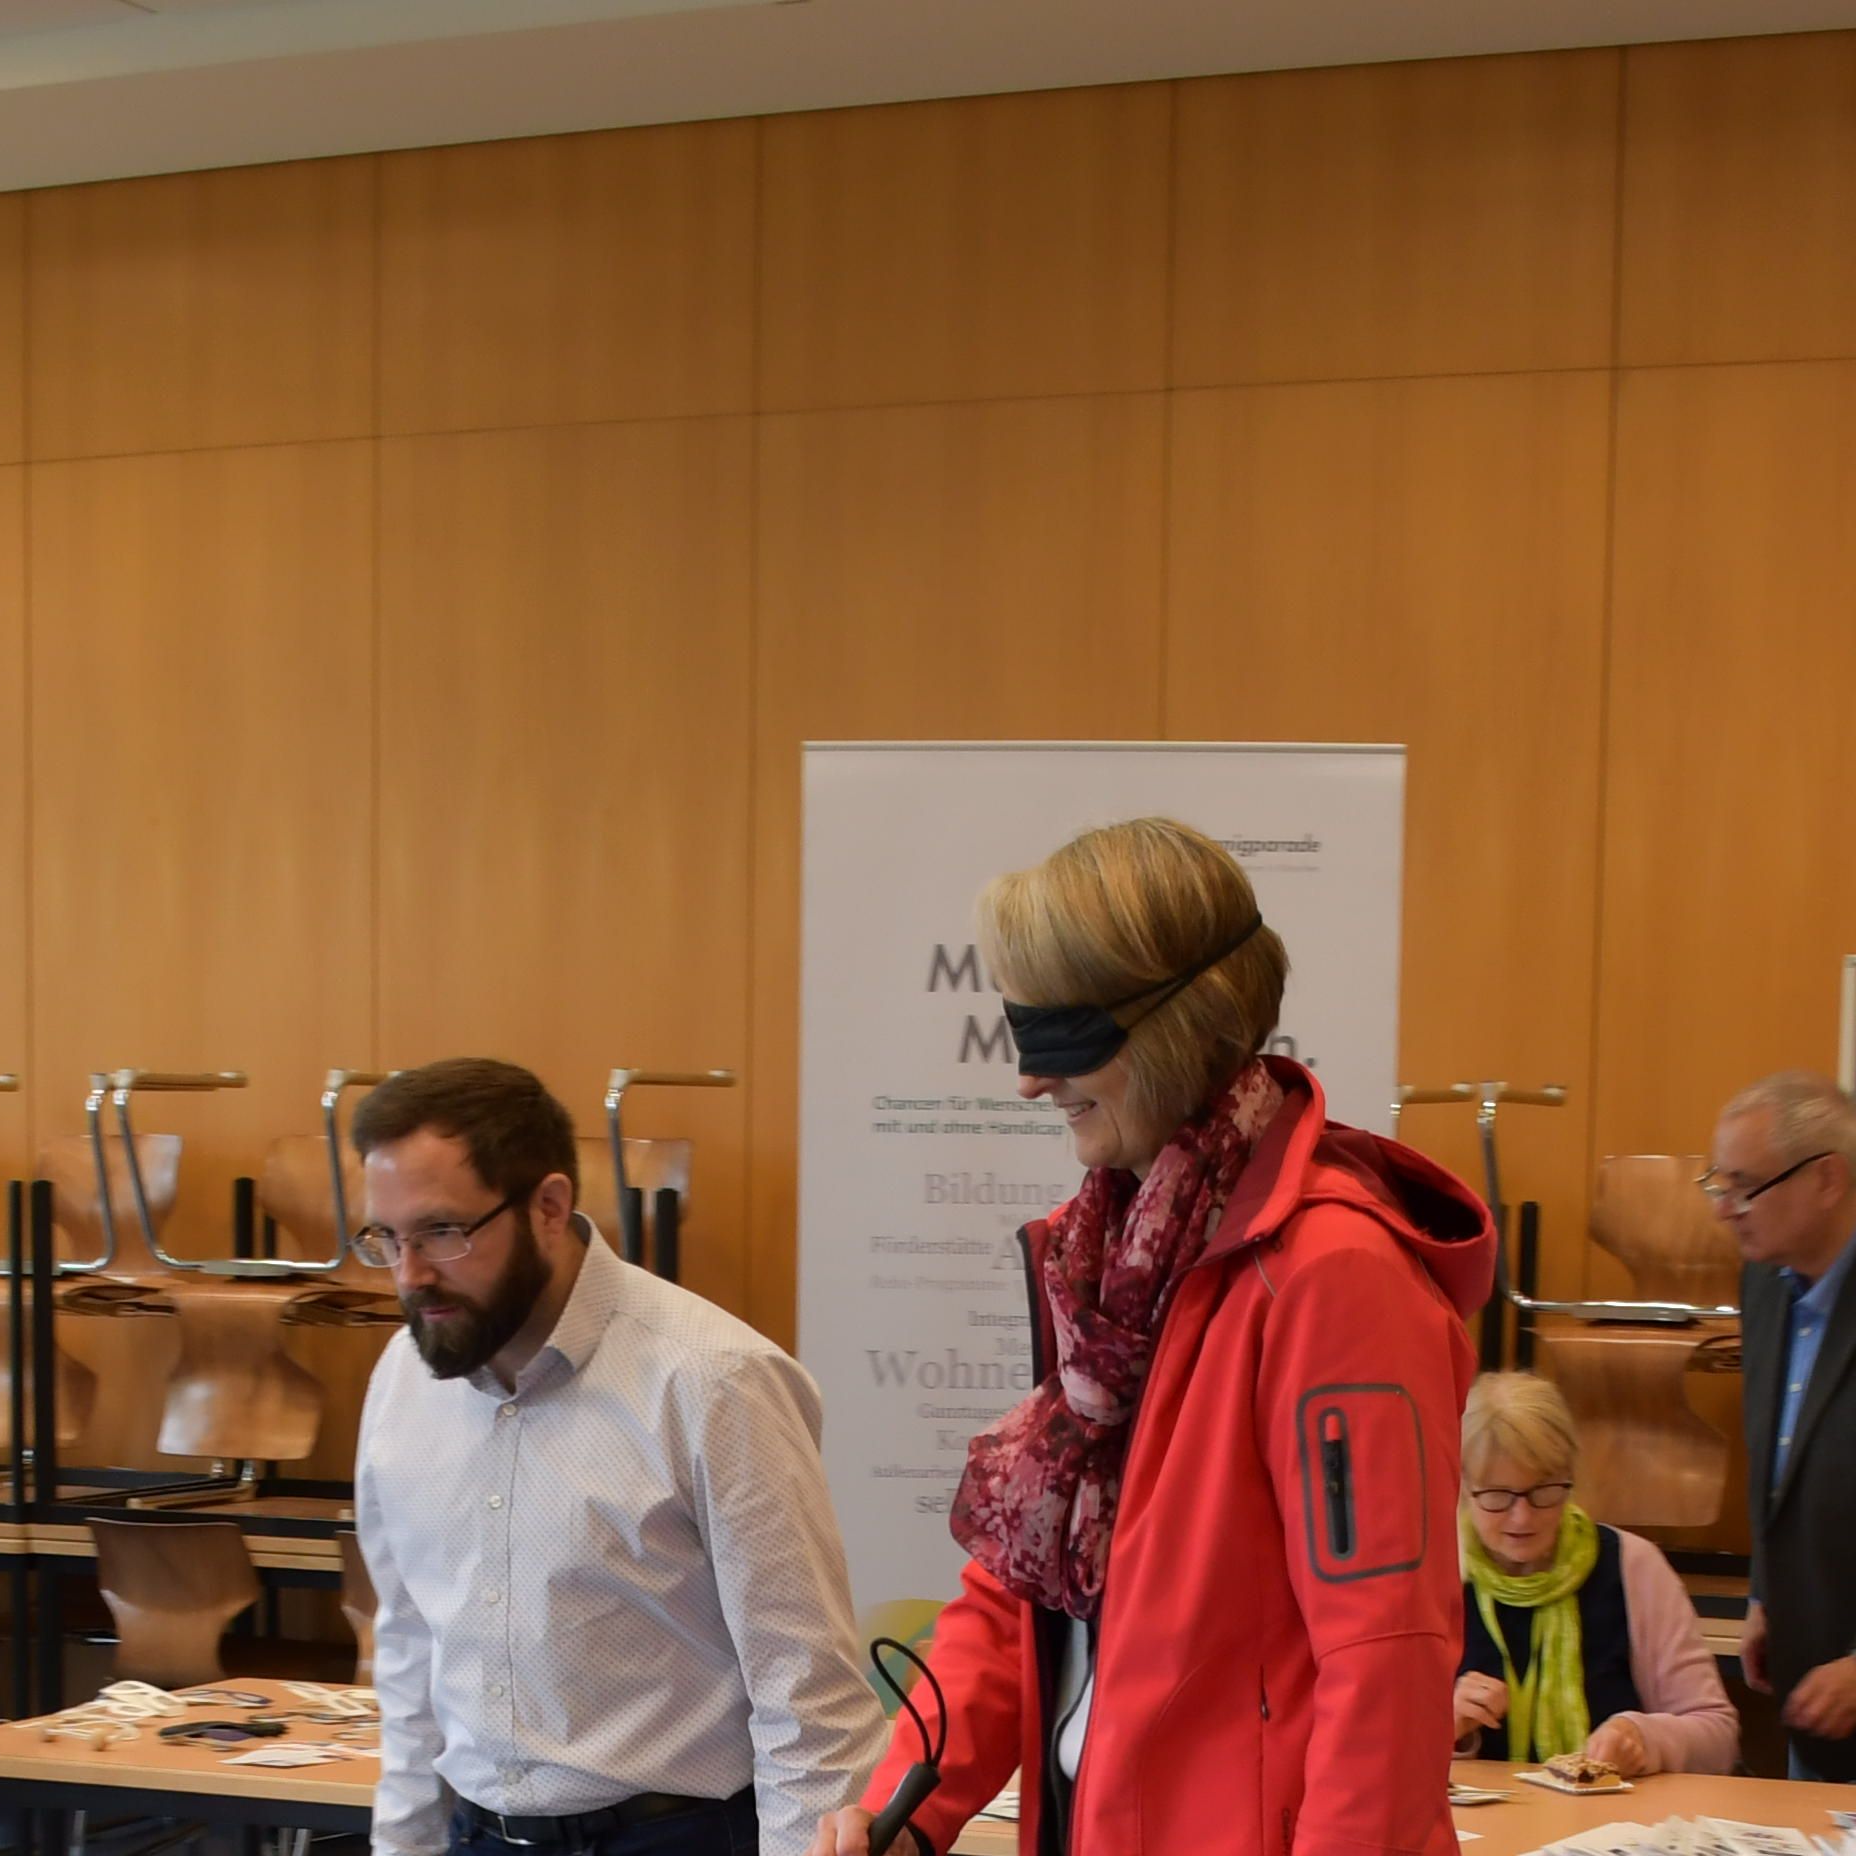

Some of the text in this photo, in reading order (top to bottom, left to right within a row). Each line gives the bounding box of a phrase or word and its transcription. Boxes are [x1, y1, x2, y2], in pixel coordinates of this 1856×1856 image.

[871, 1095, 943, 1111] Chancen
[872, 1120, 902, 1134] mit
[905, 1121, 938, 1134] und
[943, 1121, 984, 1135] ohne
